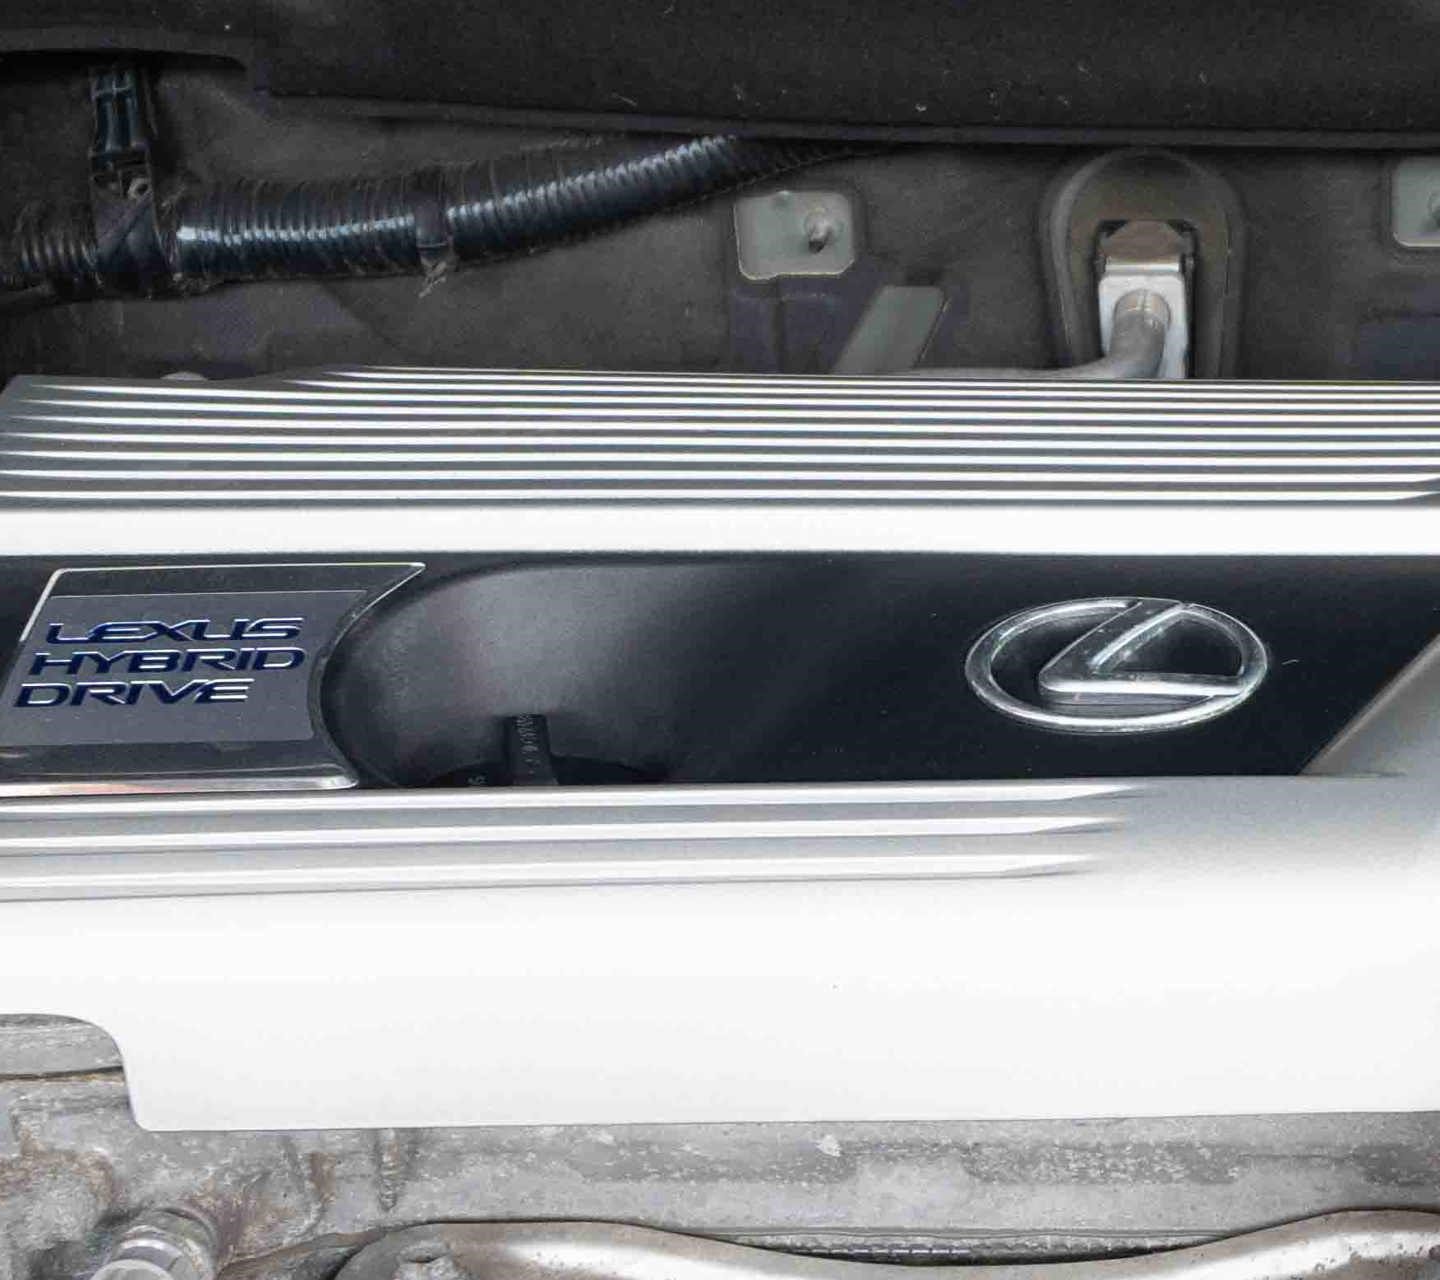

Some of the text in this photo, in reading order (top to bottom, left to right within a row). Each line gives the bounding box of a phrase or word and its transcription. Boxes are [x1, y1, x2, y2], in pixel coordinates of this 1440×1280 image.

[46, 617, 304, 644] LEXUS
[28, 646, 306, 675] HYBRID
[14, 677, 255, 707] DRIVE
